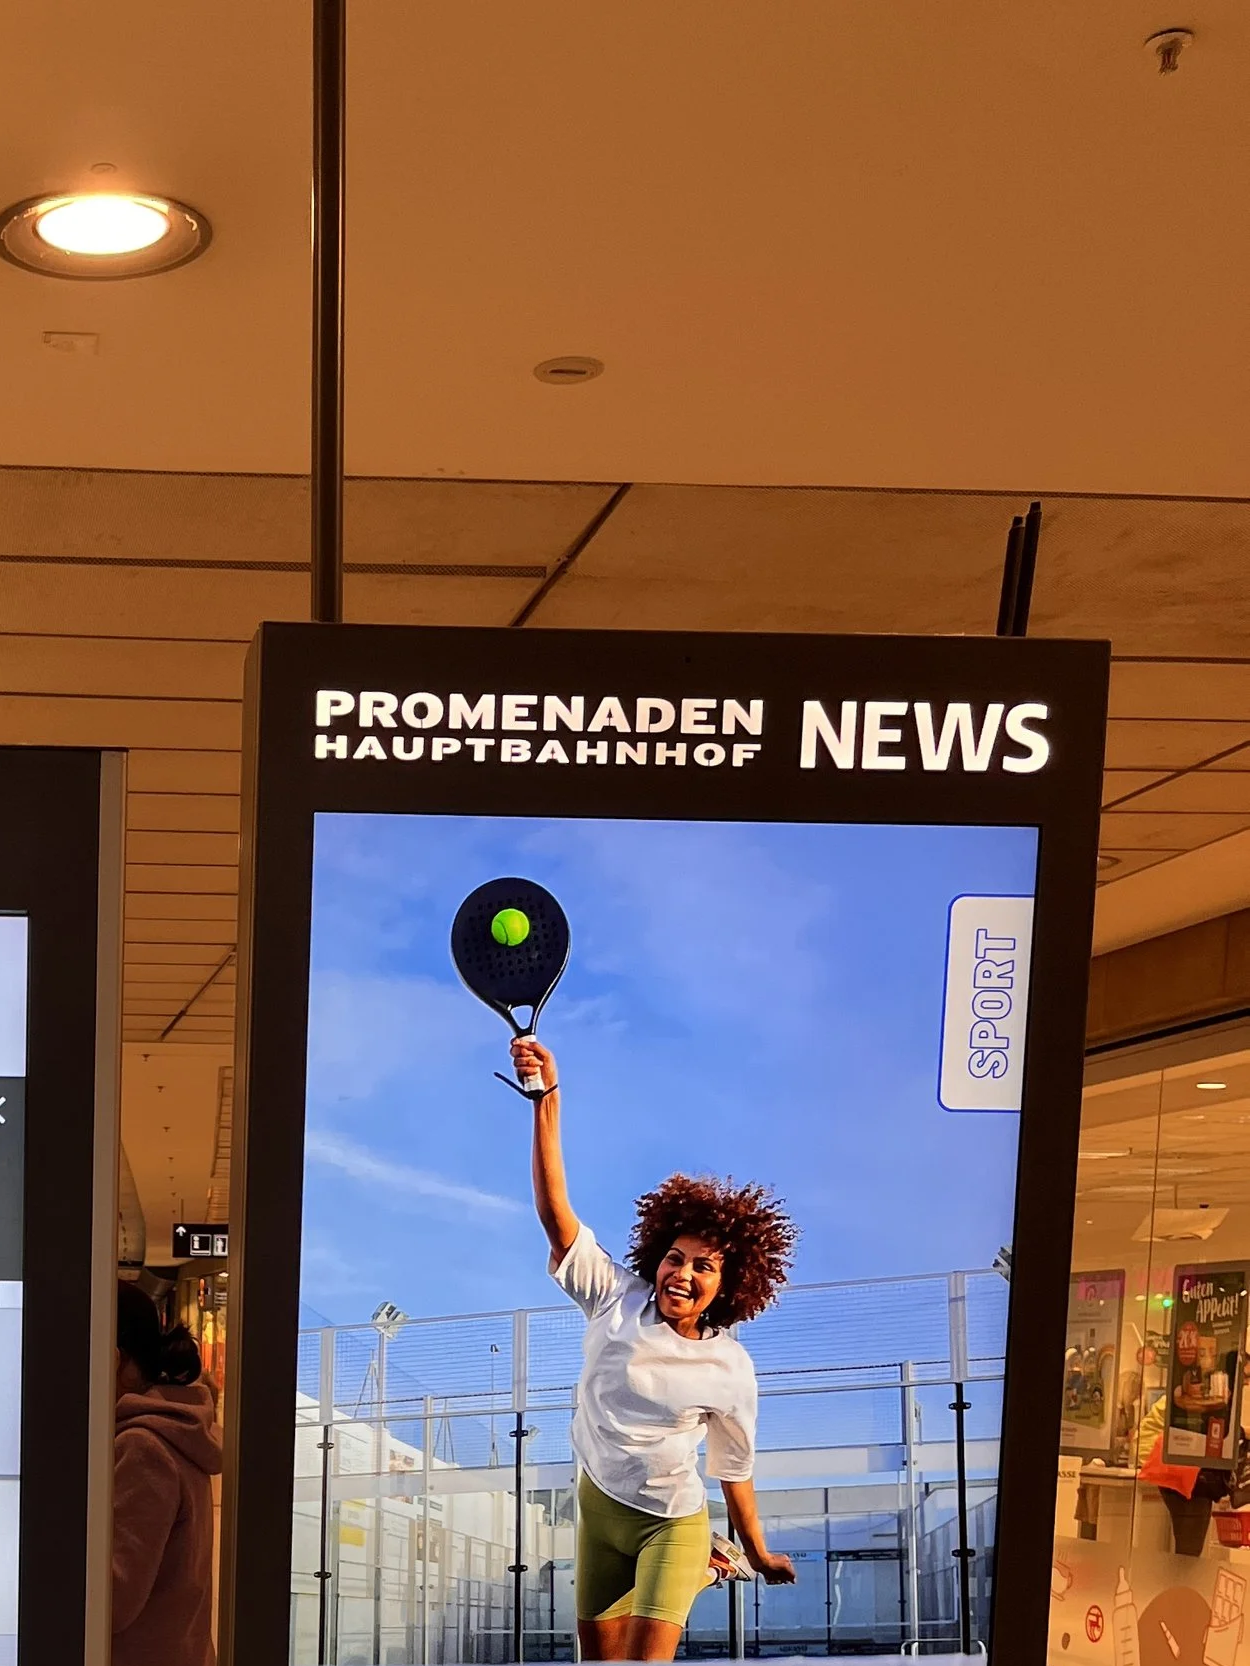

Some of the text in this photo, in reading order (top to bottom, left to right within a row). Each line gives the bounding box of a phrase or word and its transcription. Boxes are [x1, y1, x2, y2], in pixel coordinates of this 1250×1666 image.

[314, 688, 765, 737] PROMENADEN
[800, 699, 1051, 775] NEWS
[314, 733, 763, 768] HAUPTBAHNHOF
[967, 928, 1017, 1079] SPORT
